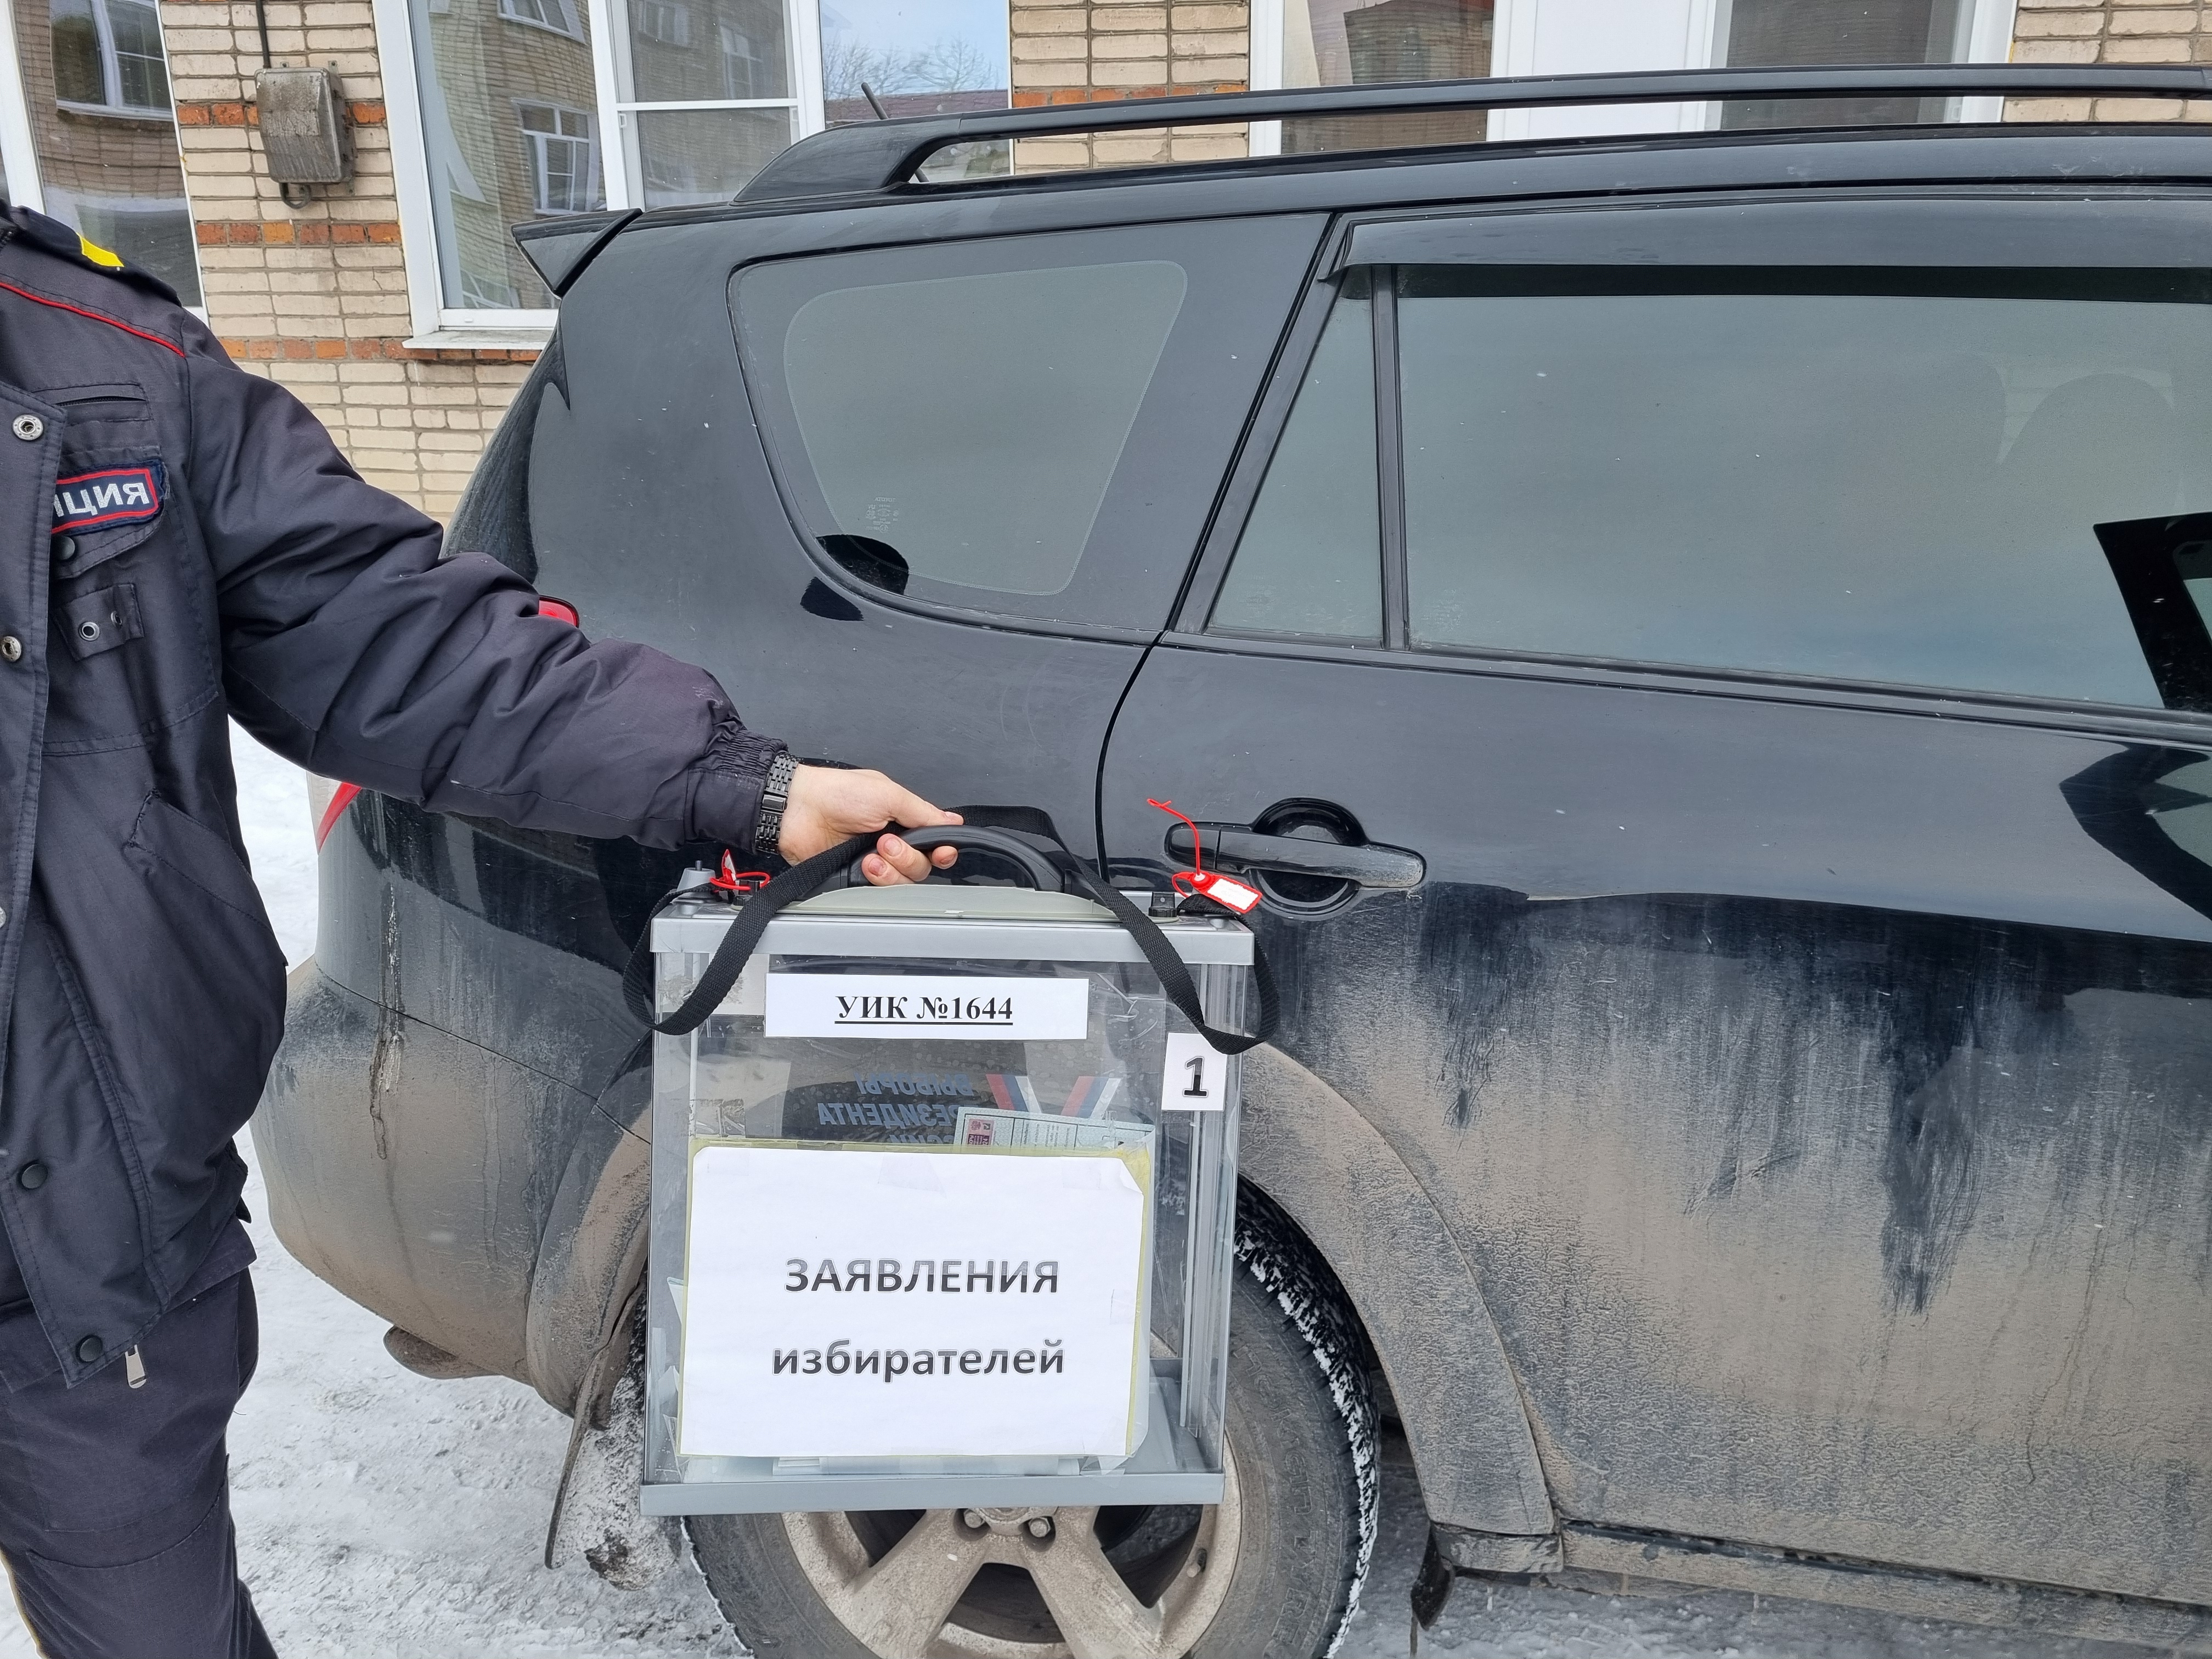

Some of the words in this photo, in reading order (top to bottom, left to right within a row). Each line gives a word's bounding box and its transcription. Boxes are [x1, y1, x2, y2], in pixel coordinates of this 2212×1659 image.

[835, 996, 909, 1019] УИК
[917, 996, 1013, 1019] №1644
[1183, 1056, 1208, 1097] 1
[785, 1258, 1059, 1294] ЗАЯВЛЕНИЯ
[772, 1338, 1064, 1383] избирателей
